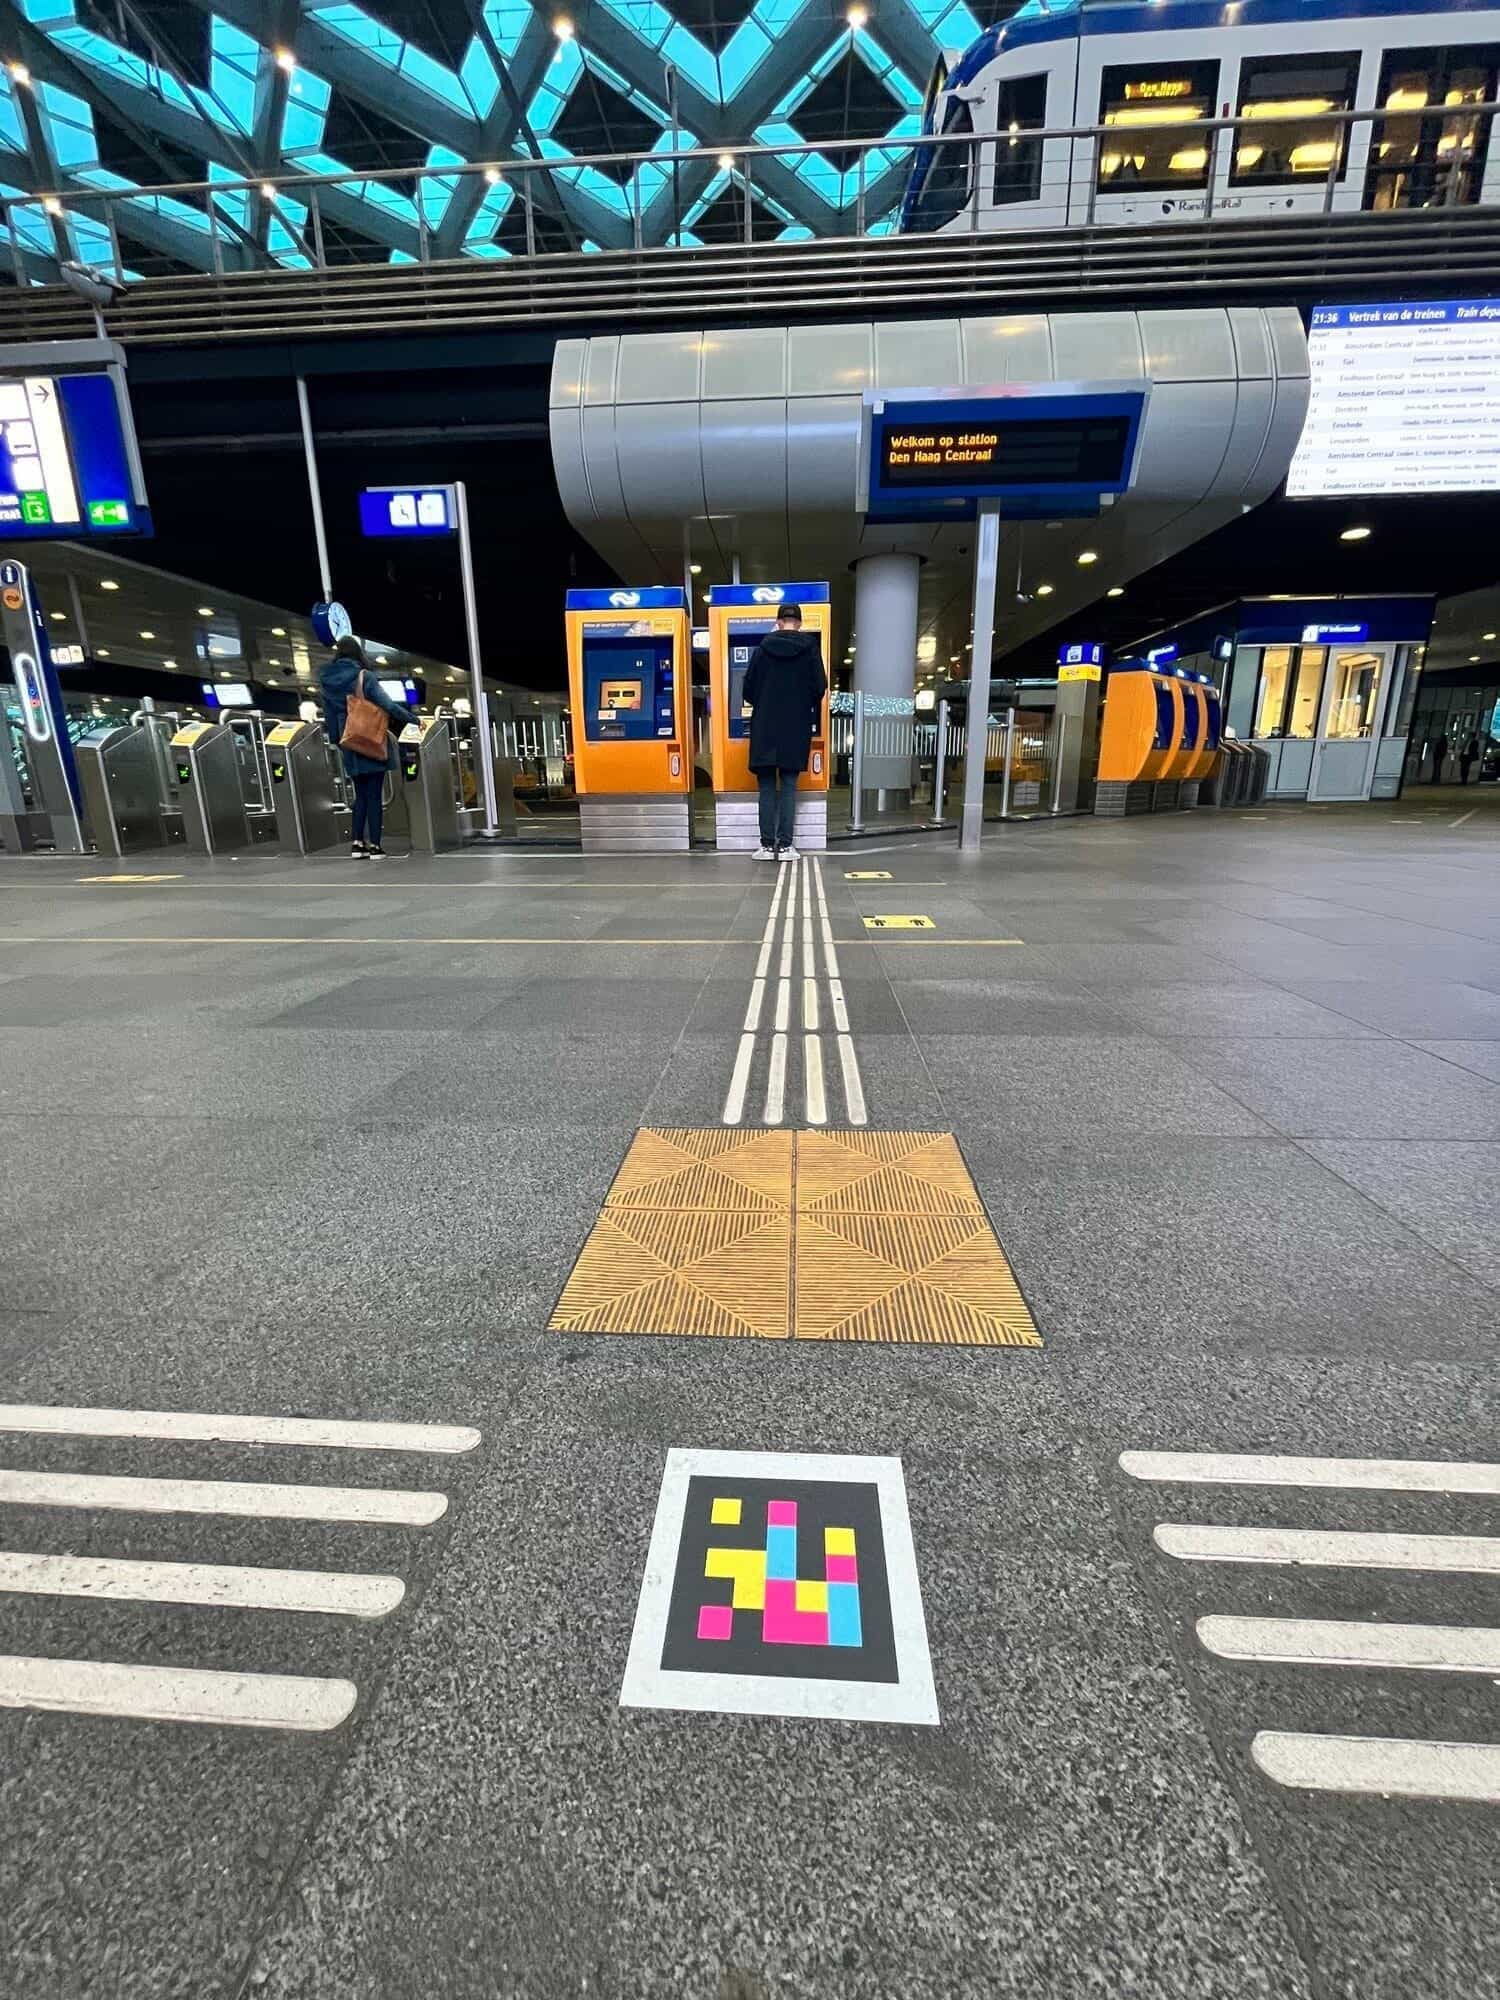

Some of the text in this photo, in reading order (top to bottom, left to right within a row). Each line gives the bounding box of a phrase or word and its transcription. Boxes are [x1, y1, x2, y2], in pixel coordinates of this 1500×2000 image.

[1312, 311, 1339, 324] 21:36
[1348, 310, 1381, 322] Vertrek
[1383, 311, 1399, 321] van
[1400, 309, 1412, 320] de
[1414, 308, 1446, 320] treinen
[1456, 306, 1479, 318] Train
[890, 433, 998, 448] Welkom op station
[889, 448, 992, 463] Den Haag Centraal
